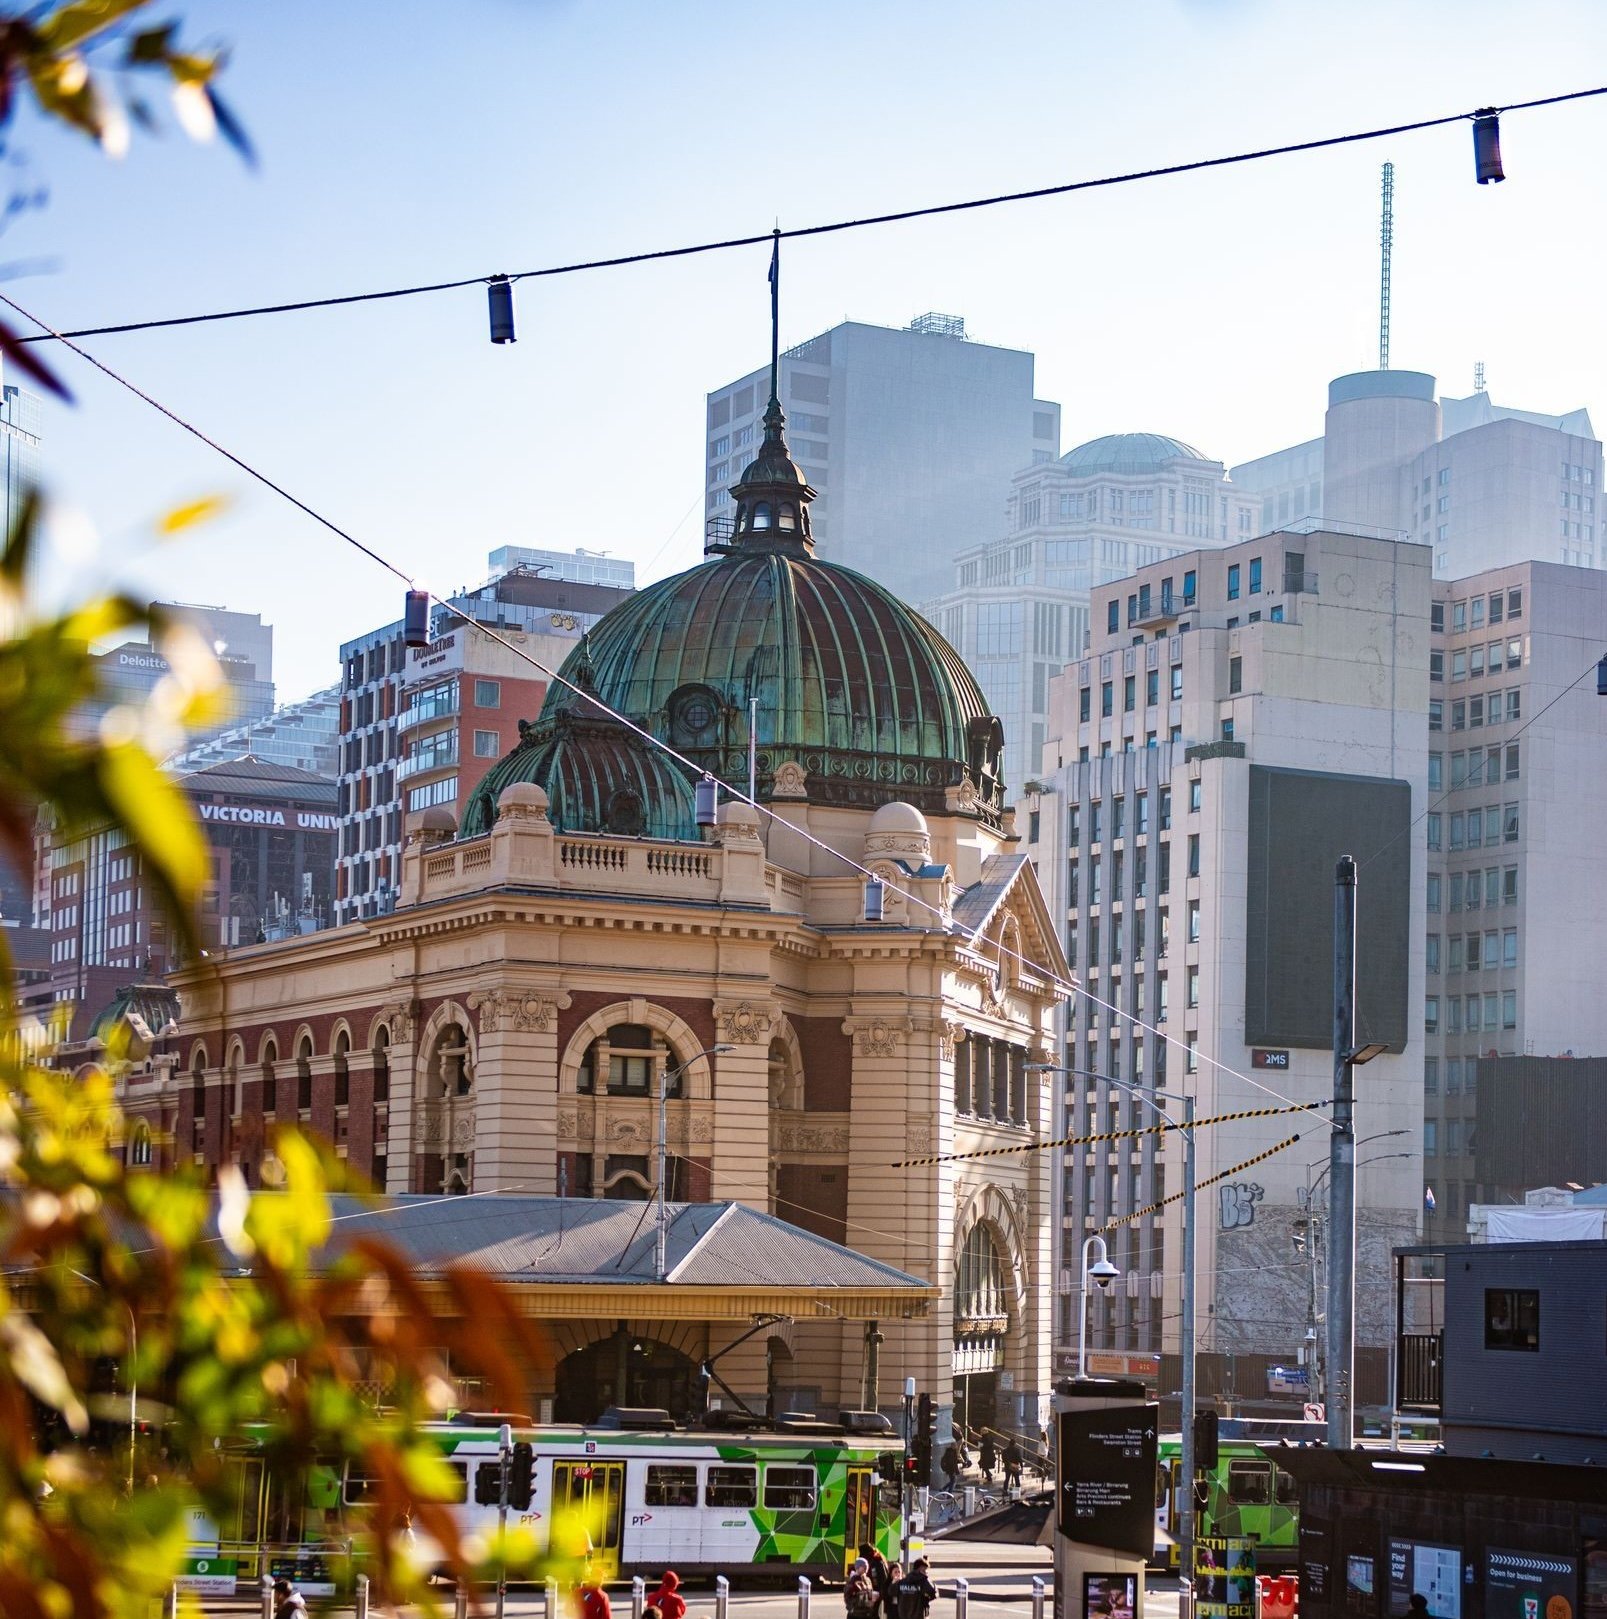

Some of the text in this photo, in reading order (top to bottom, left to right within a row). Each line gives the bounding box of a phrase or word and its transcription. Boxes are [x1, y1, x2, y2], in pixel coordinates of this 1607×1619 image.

[120, 654, 167, 669] Deloitte
[199, 804, 285, 826] VICTORIA
[574, 1467, 591, 1476] STOP
[1391, 1553, 1406, 1563] Find
[1391, 1563, 1406, 1571] your
[1391, 1571, 1404, 1580] way
[1489, 1568, 1543, 1583] Open for business
